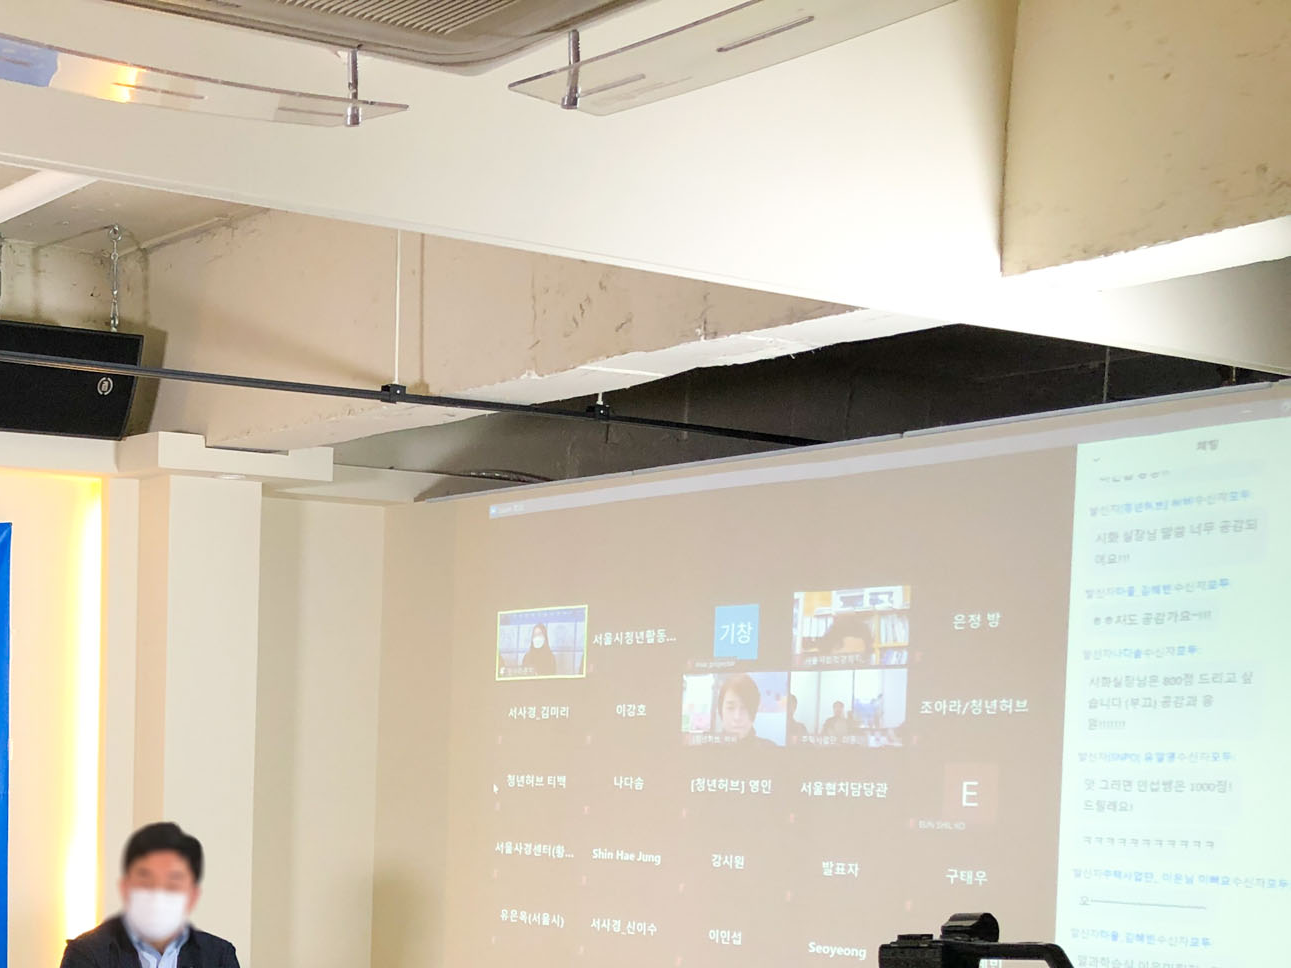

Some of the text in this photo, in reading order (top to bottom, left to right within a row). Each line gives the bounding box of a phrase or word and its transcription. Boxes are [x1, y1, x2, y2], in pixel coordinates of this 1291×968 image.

[953, 611, 1000, 630] 은정 방
[719, 622, 753, 645] 기창
[508, 705, 570, 720] 서사경_김미리
[616, 704, 647, 718] 이강호
[919, 699, 1029, 715] 조아라/청년허브
[506, 774, 545, 788] 청년허브
[613, 776, 645, 791] 나다솜
[691, 778, 772, 794] [청년허브] 영인
[800, 781, 888, 798] 서울협치담당관
[962, 782, 979, 807] E
[592, 848, 662, 866] Shin Hae Jung
[711, 854, 745, 870] 강시원
[821, 861, 860, 878] 발표자
[945, 868, 989, 886] 구태우
[709, 929, 743, 945] 이인섭
[808, 941, 867, 960] Seoyeong
